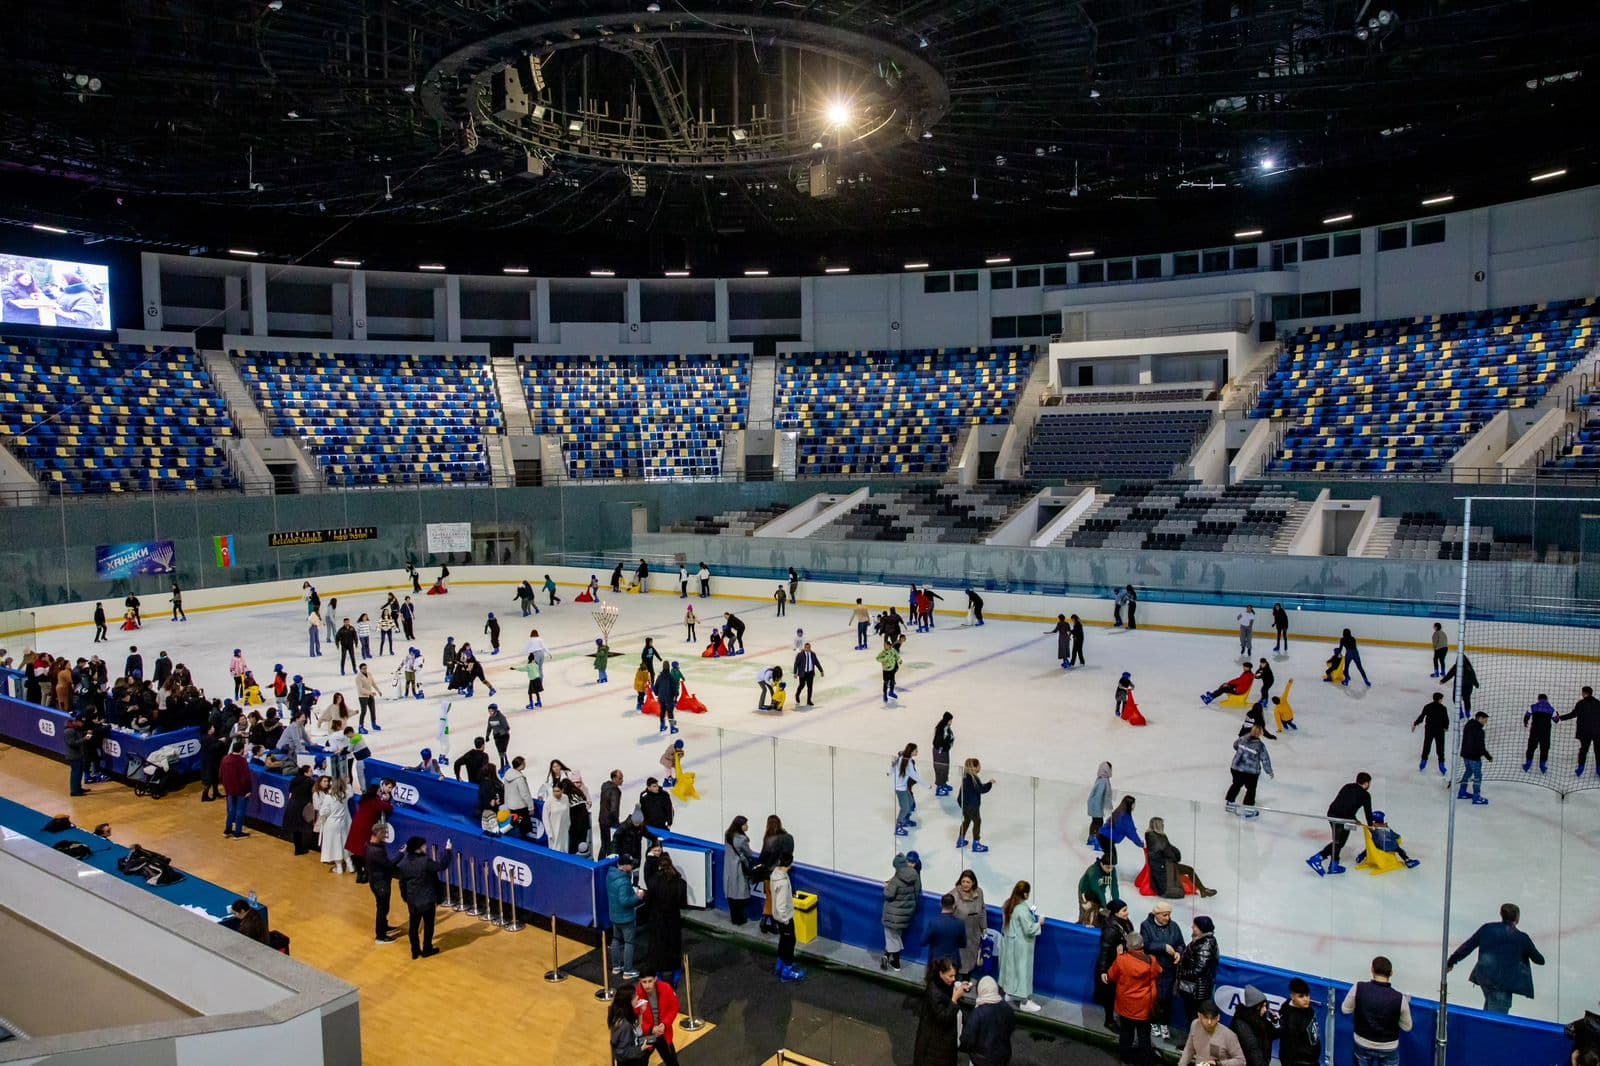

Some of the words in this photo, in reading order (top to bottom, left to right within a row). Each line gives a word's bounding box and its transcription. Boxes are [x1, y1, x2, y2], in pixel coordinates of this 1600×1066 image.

[177, 742, 195, 755] ZE
[263, 788, 281, 804] AZE
[393, 785, 413, 801] AZE
[1228, 992, 1281, 1020] AE
